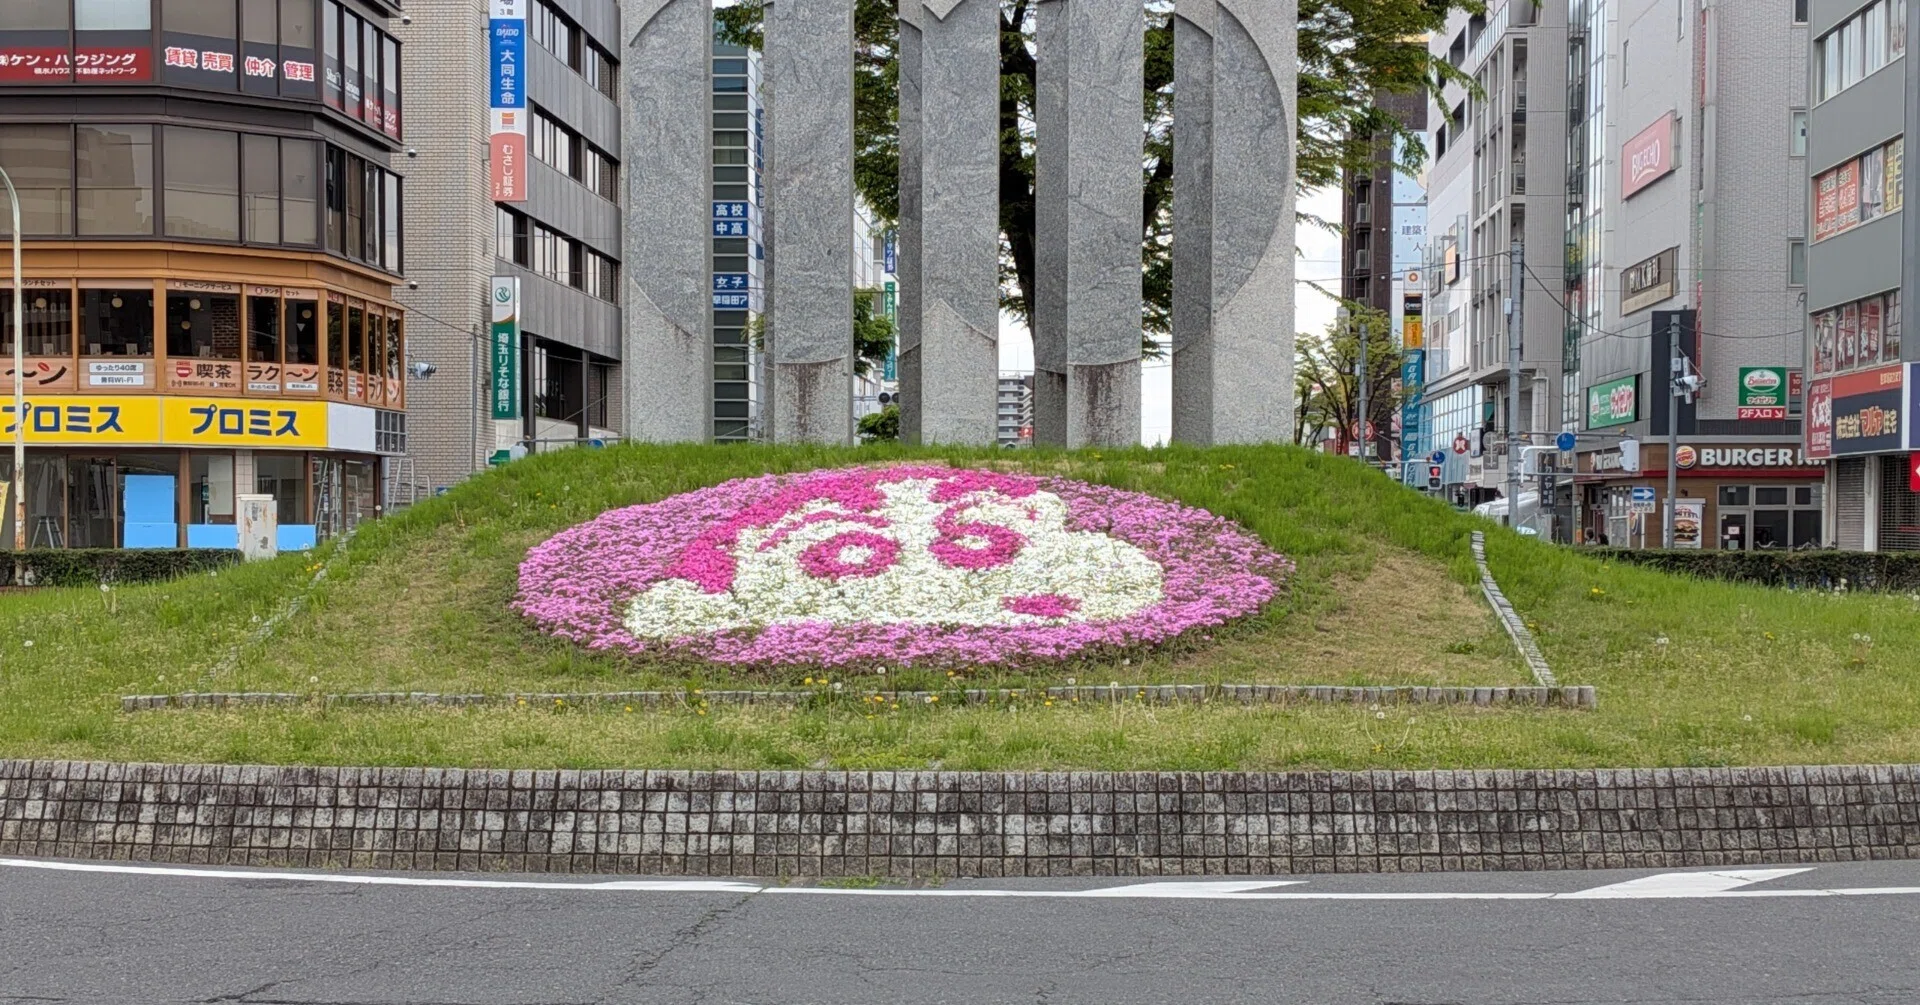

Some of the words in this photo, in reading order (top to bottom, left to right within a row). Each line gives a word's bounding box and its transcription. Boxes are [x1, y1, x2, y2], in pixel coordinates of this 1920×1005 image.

[165, 47, 198, 68] 賃貸
[202, 51, 234, 72] 売買
[245, 56, 276, 77] 仲介
[284, 61, 315, 82] 管理
[500, 49, 515, 105] 大同生命
[502, 144, 514, 197] むさし証券
[716, 204, 743, 216] 高校
[716, 222, 743, 235] 中高
[716, 276, 743, 289] 女子
[713, 295, 747, 305] 早稲田ア
[196, 363, 232, 379] 喫茶
[247, 366, 280, 381] ラク
[497, 332, 510, 413] 埼玉りそな銀行
[2, 402, 124, 433] プロミス
[190, 403, 301, 437] プロミス
[1740, 408, 1773, 418] 2F入口
[1700, 448, 1794, 466] BURGER
